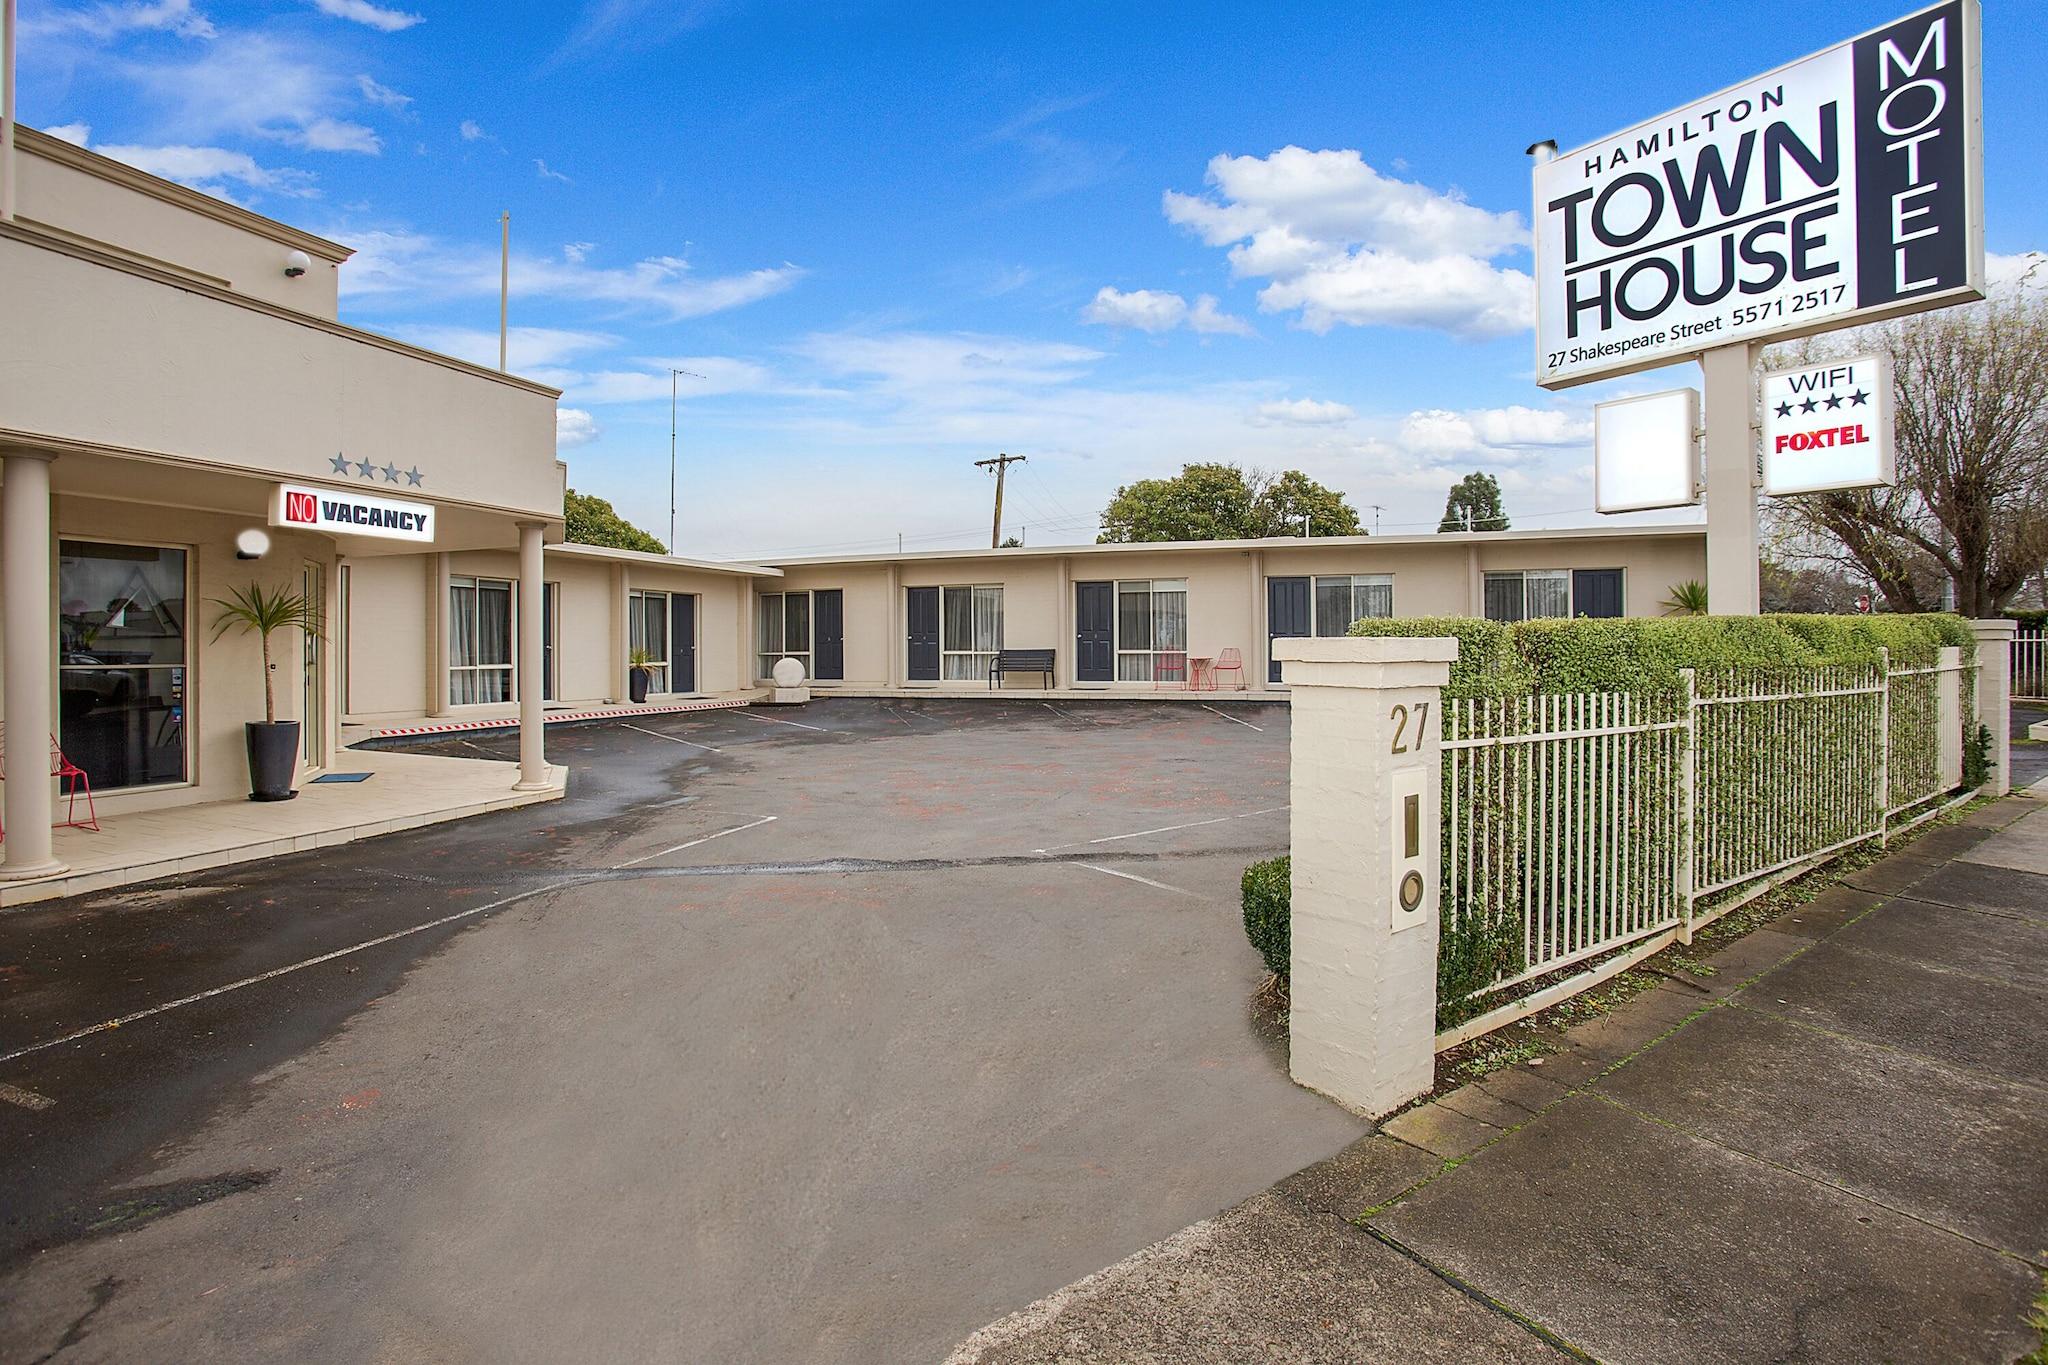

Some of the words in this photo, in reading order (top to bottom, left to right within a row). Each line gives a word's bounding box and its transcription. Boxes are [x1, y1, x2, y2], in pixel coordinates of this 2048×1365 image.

[1584, 85, 1784, 178] HAMILTON
[1876, 17, 1946, 295] MOTEL
[1548, 100, 1839, 265] TOWN
[1566, 202, 1839, 339] HOUSE
[1547, 351, 1566, 368] 27
[1569, 330, 1666, 363] Shakespeare
[1670, 316, 1722, 341] Street
[1732, 299, 1783, 326] 5571
[1791, 284, 1847, 313] 2517
[1788, 366, 1853, 394] WIFI
[1775, 424, 1870, 454] FOXTEL
[288, 493, 316, 523] NO
[322, 500, 427, 532] VACANCY
[1390, 702, 1429, 754] 27
